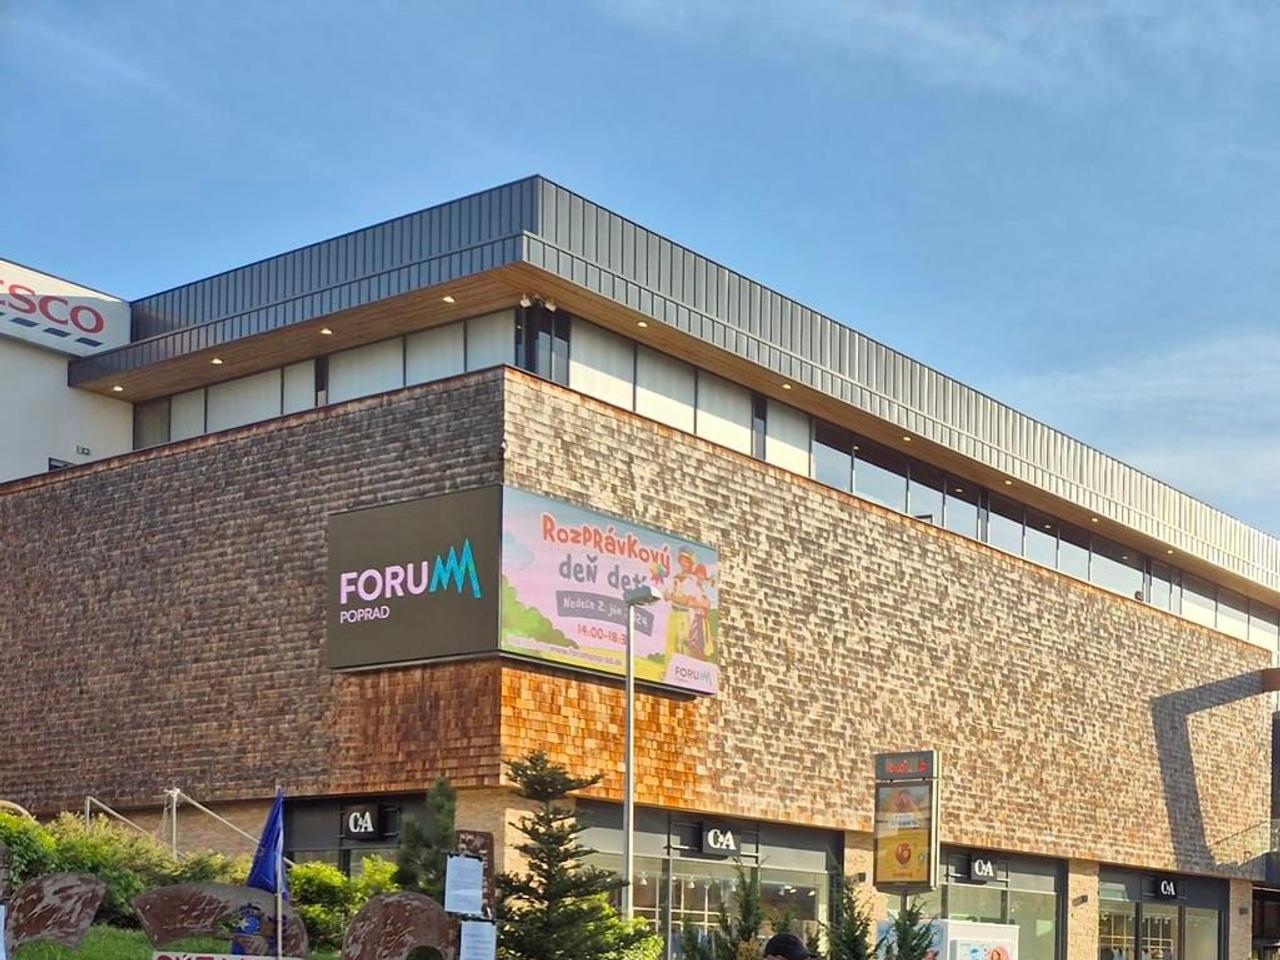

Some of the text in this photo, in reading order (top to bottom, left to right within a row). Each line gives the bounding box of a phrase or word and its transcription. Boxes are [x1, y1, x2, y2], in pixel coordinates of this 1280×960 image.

[0, 279, 104, 334] SCO
[340, 538, 481, 605] FORUM
[340, 605, 390, 624] POPRAD
[348, 811, 374, 833] C&A
[707, 828, 737, 850] C&A
